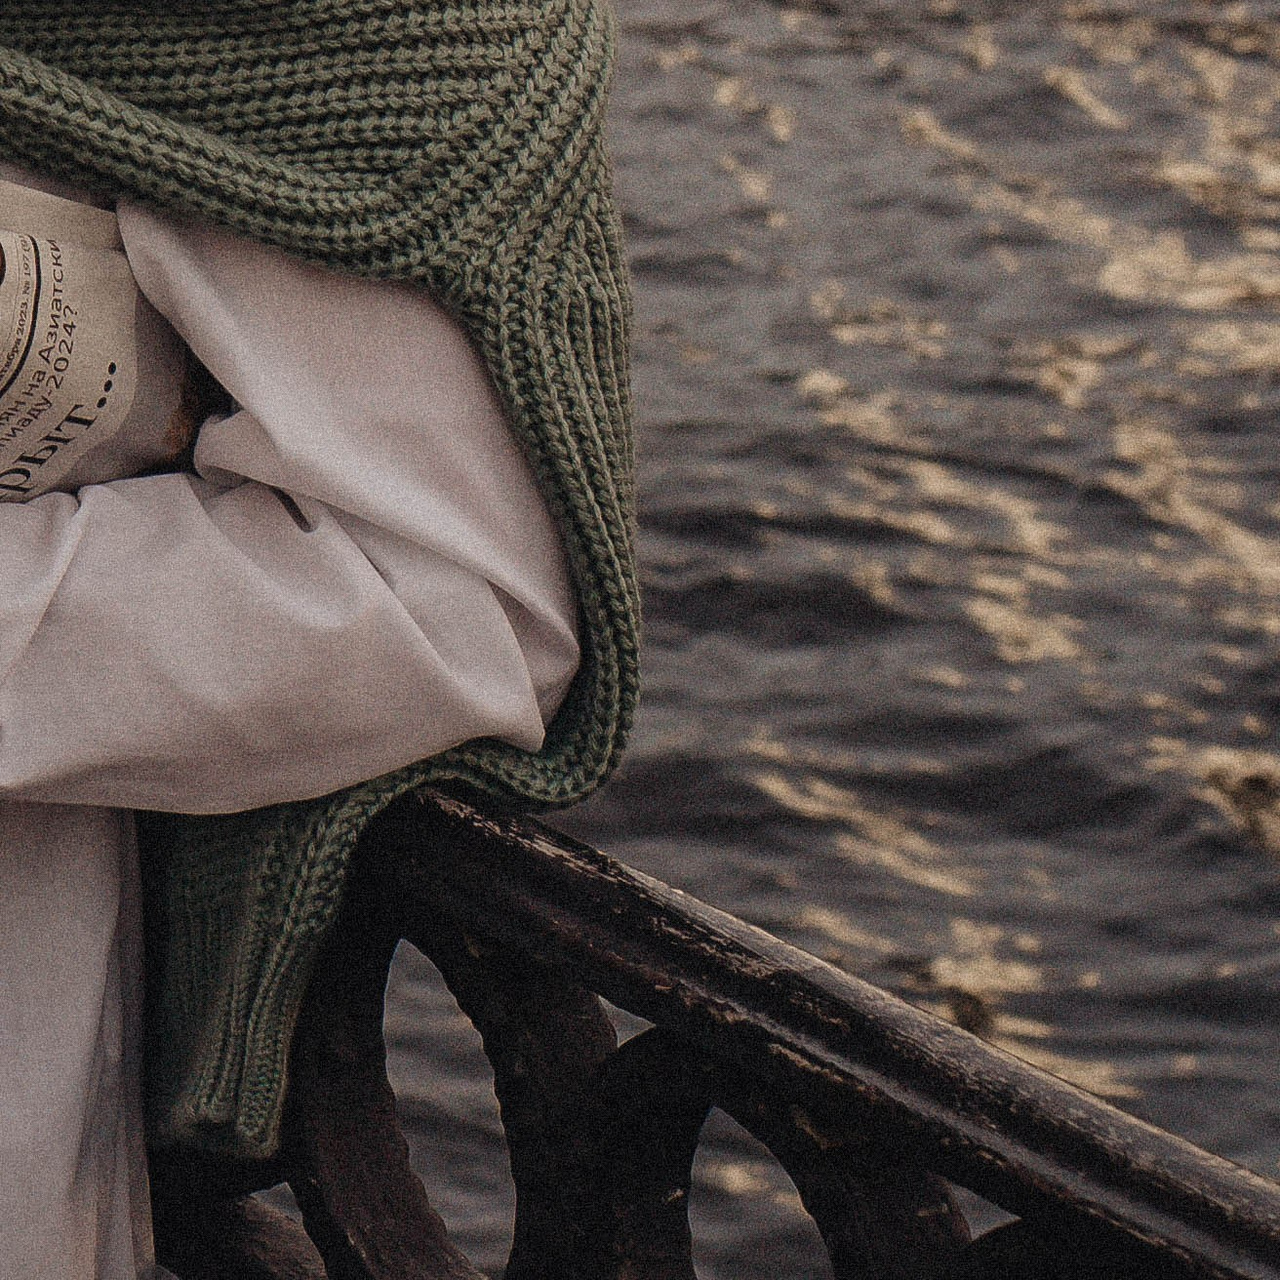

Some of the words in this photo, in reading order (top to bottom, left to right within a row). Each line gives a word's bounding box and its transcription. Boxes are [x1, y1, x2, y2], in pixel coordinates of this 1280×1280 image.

[22, 253, 32, 278] 197
[22, 370, 47, 397] на
[38, 239, 65, 365] Азиатски
